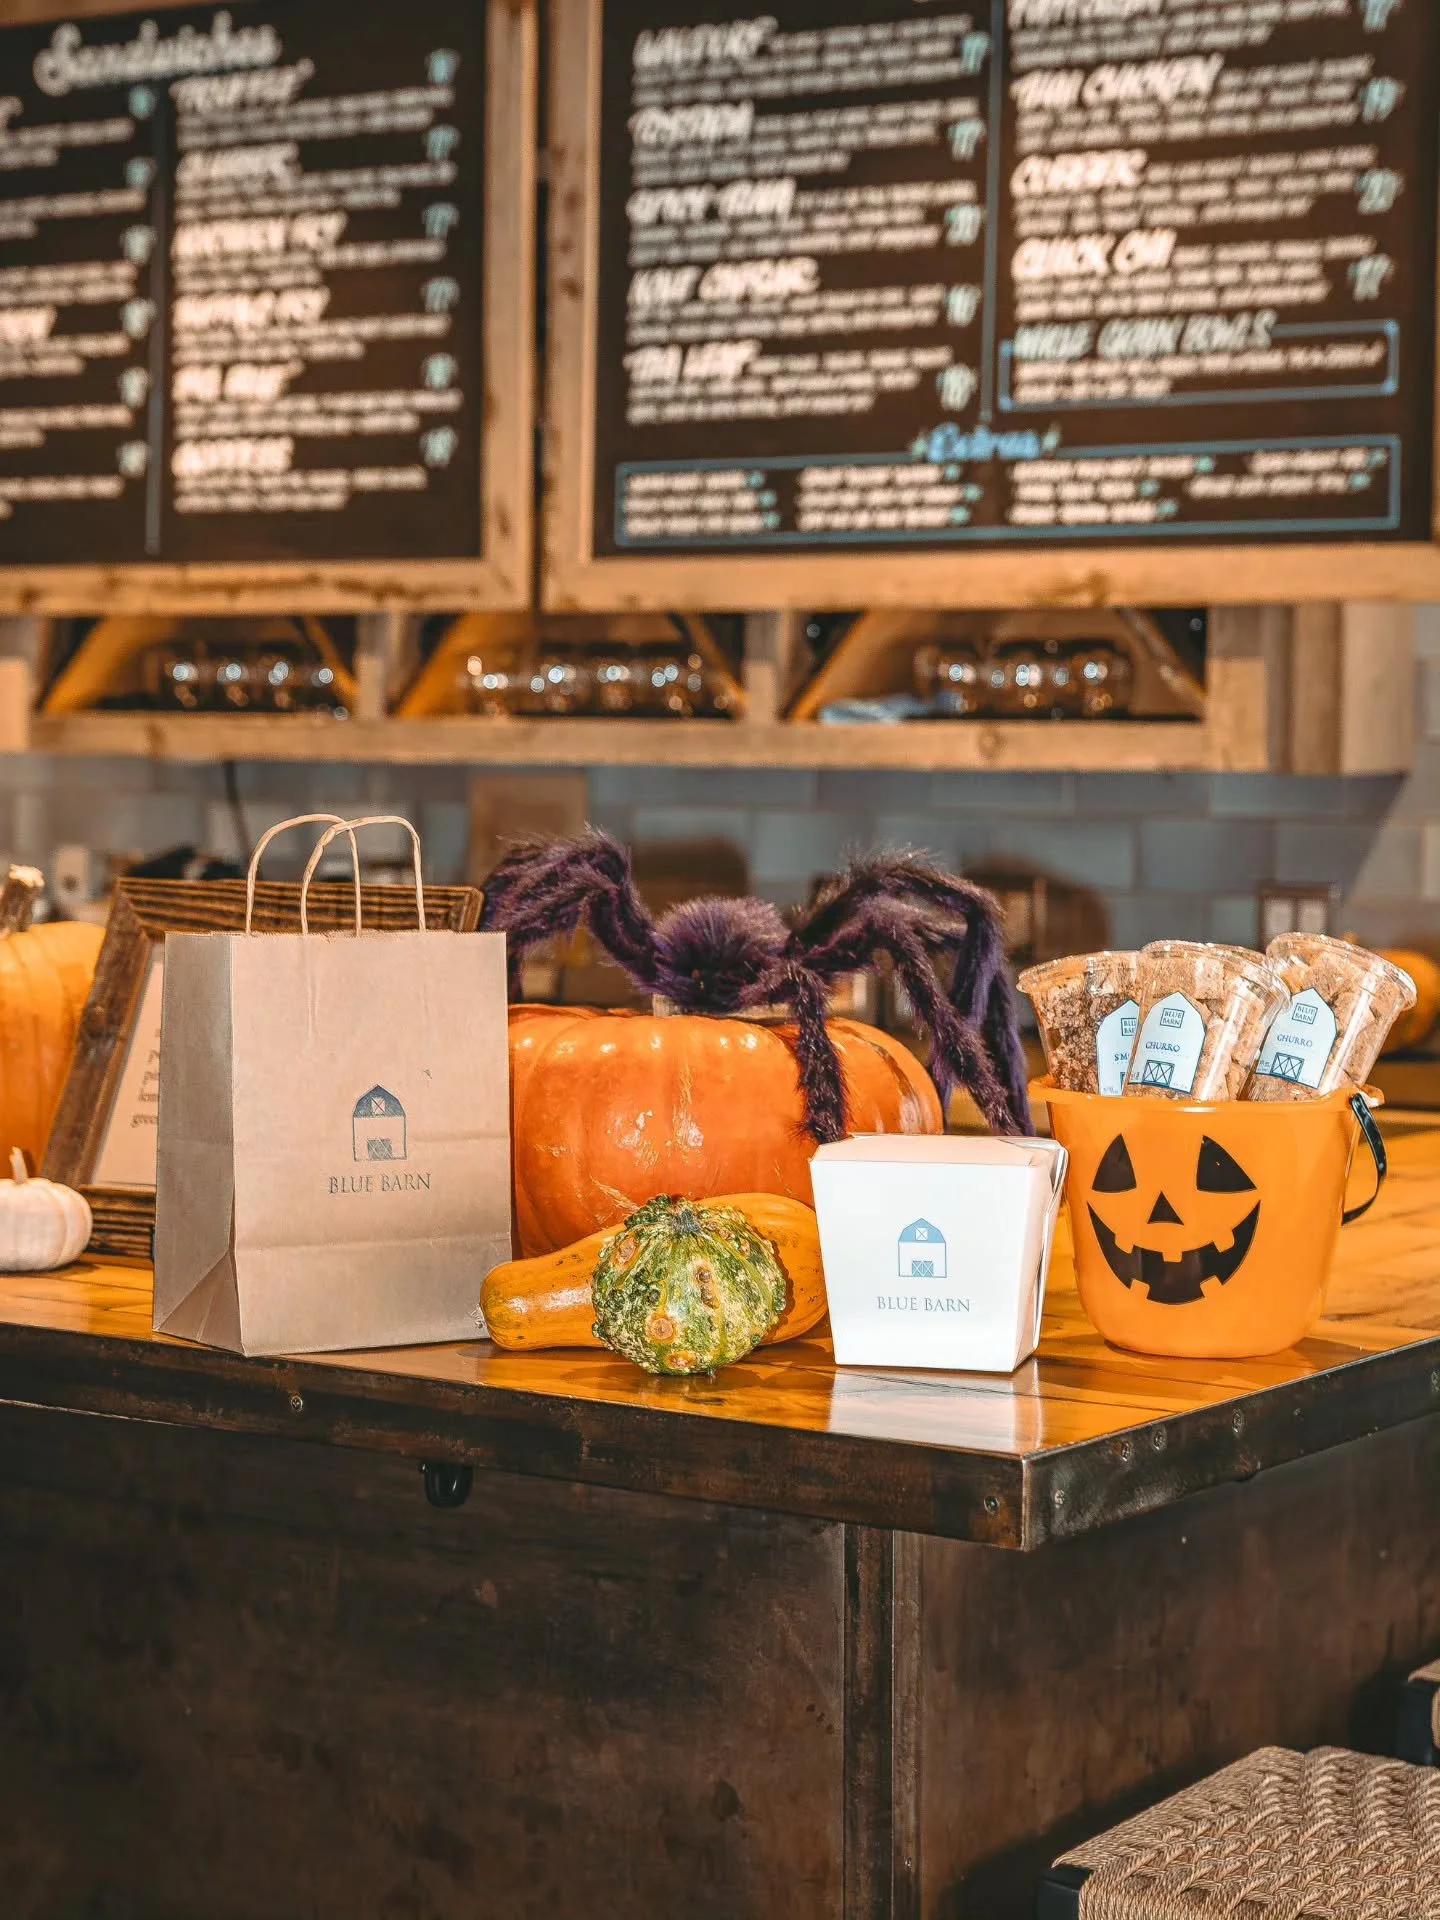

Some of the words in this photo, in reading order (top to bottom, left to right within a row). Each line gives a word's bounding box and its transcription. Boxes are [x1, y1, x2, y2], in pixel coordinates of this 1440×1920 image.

[1163, 1011, 1183, 1019] BLUE
[1297, 1006, 1316, 1016] BLUE
[1162, 1017, 1181, 1026] BARN
[1295, 1013, 1314, 1022] BARN
[1277, 1034, 1313, 1048] CHURRO
[1145, 1041, 1181, 1053] CHURRO
[328, 1175, 374, 1194] BLUE
[380, 1172, 431, 1192] BARN
[877, 1296, 918, 1311] BLUE
[924, 1297, 970, 1313] BARN
